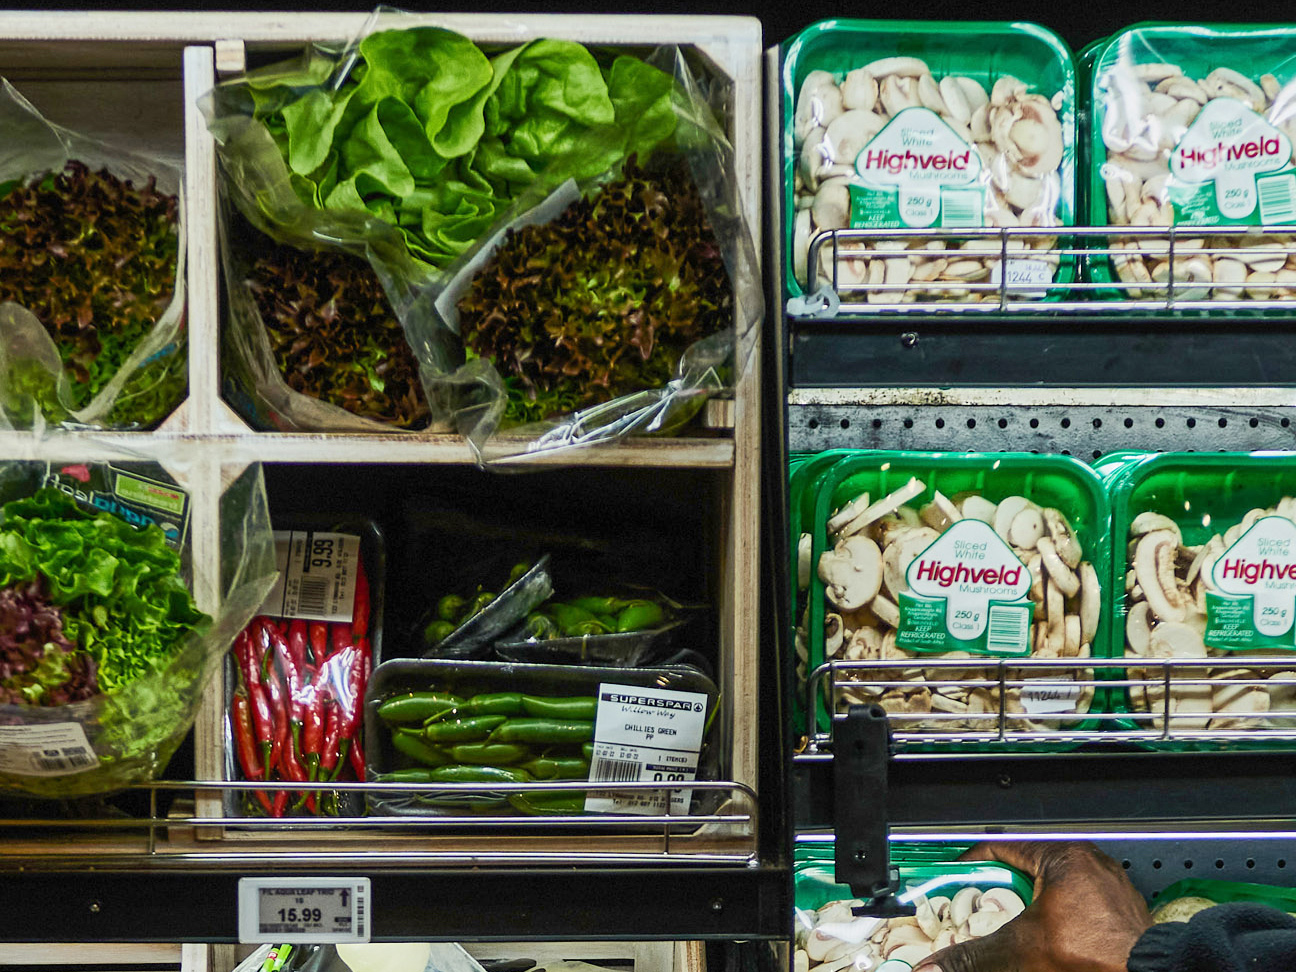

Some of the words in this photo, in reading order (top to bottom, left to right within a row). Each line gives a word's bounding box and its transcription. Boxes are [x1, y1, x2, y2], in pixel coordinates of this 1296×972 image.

[903, 137, 932, 146] White
[1181, 134, 1280, 169] Highveld
[866, 150, 969, 174] Highveld
[1225, 188, 1241, 198] 250
[907, 196, 925, 205] 250
[954, 540, 986, 550] Sliced
[1258, 538, 1290, 547] Sliced
[312, 539, 333, 567] 9.99
[955, 550, 985, 560] White
[1259, 547, 1289, 556] White
[917, 560, 1021, 587] Highveld
[959, 585, 1017, 595] Mushrooms
[955, 611, 973, 619] 250
[1262, 608, 1280, 616] 250
[953, 622, 974, 630] Class
[1260, 617, 1280, 626] Class
[901, 631, 945, 640] REFRIGERATED
[611, 694, 692, 711] SUPERSPAR
[621, 705, 655, 714] Willow
[656, 709, 676, 720] Way
[624, 723, 655, 734] CHILLIES
[658, 727, 677, 736] GREEN
[278, 909, 321, 921] 15.99
